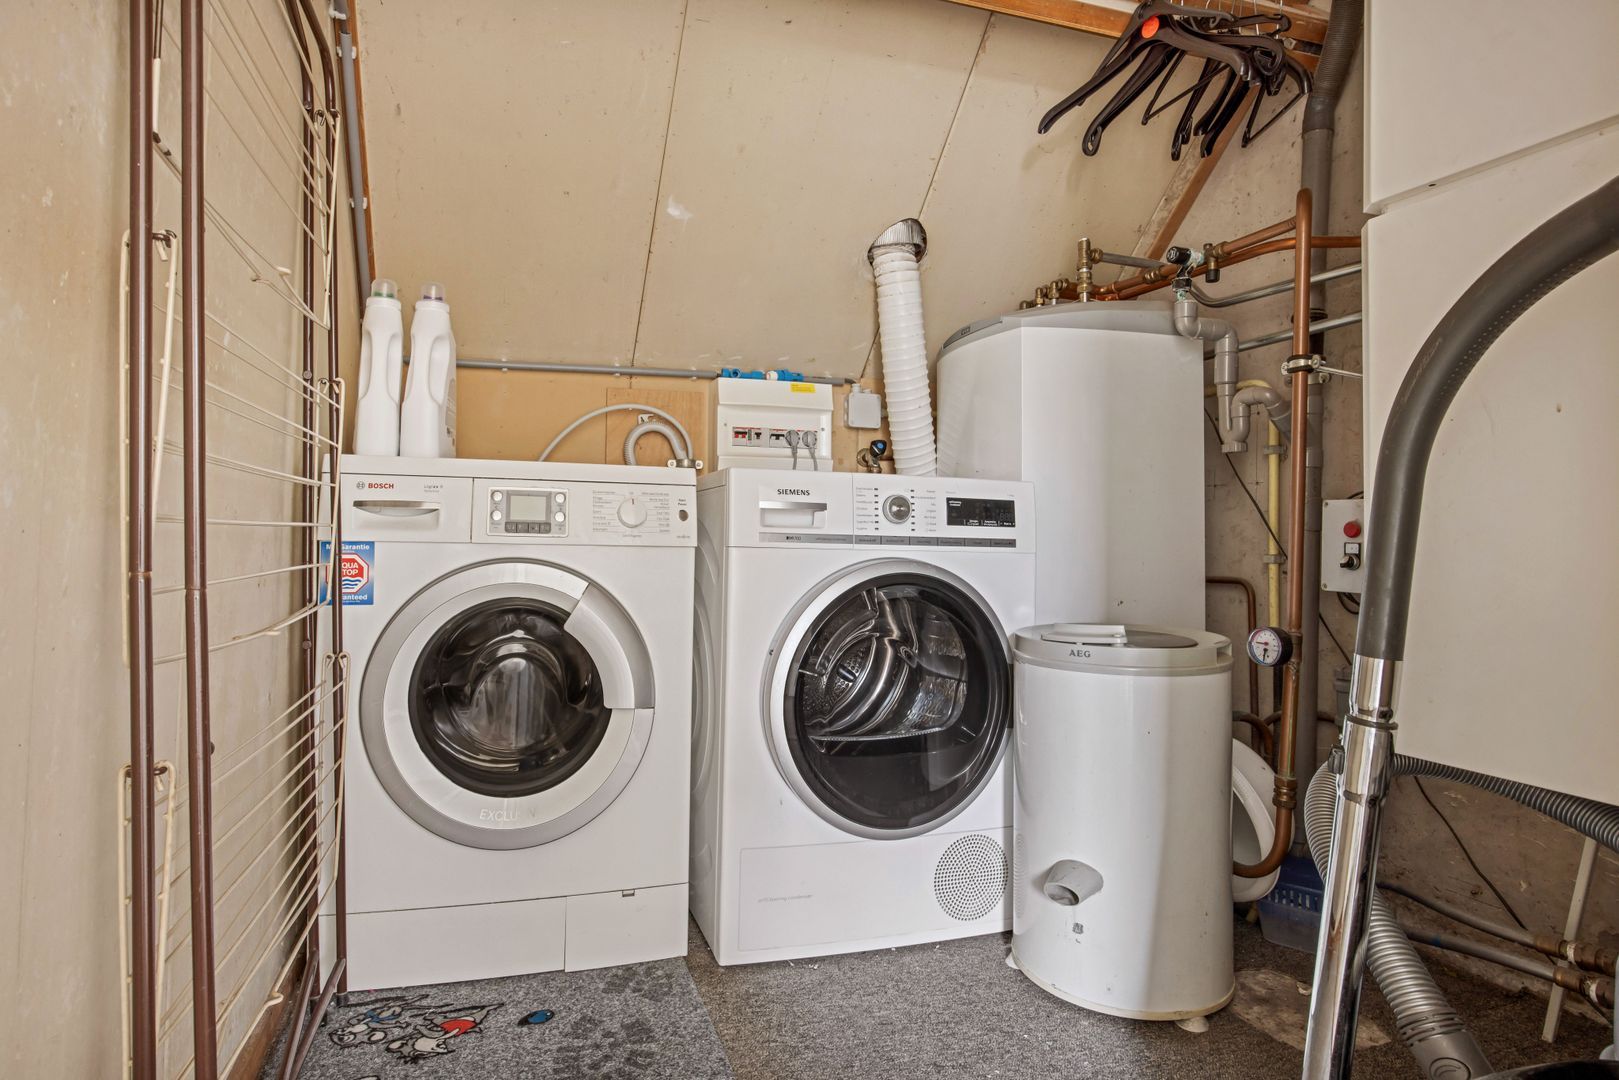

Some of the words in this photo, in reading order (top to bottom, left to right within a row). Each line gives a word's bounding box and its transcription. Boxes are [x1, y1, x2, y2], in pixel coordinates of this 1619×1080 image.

[777, 488, 811, 496] SIEMENS
[342, 568, 359, 576] TOP
[1069, 649, 1092, 658] AEG
